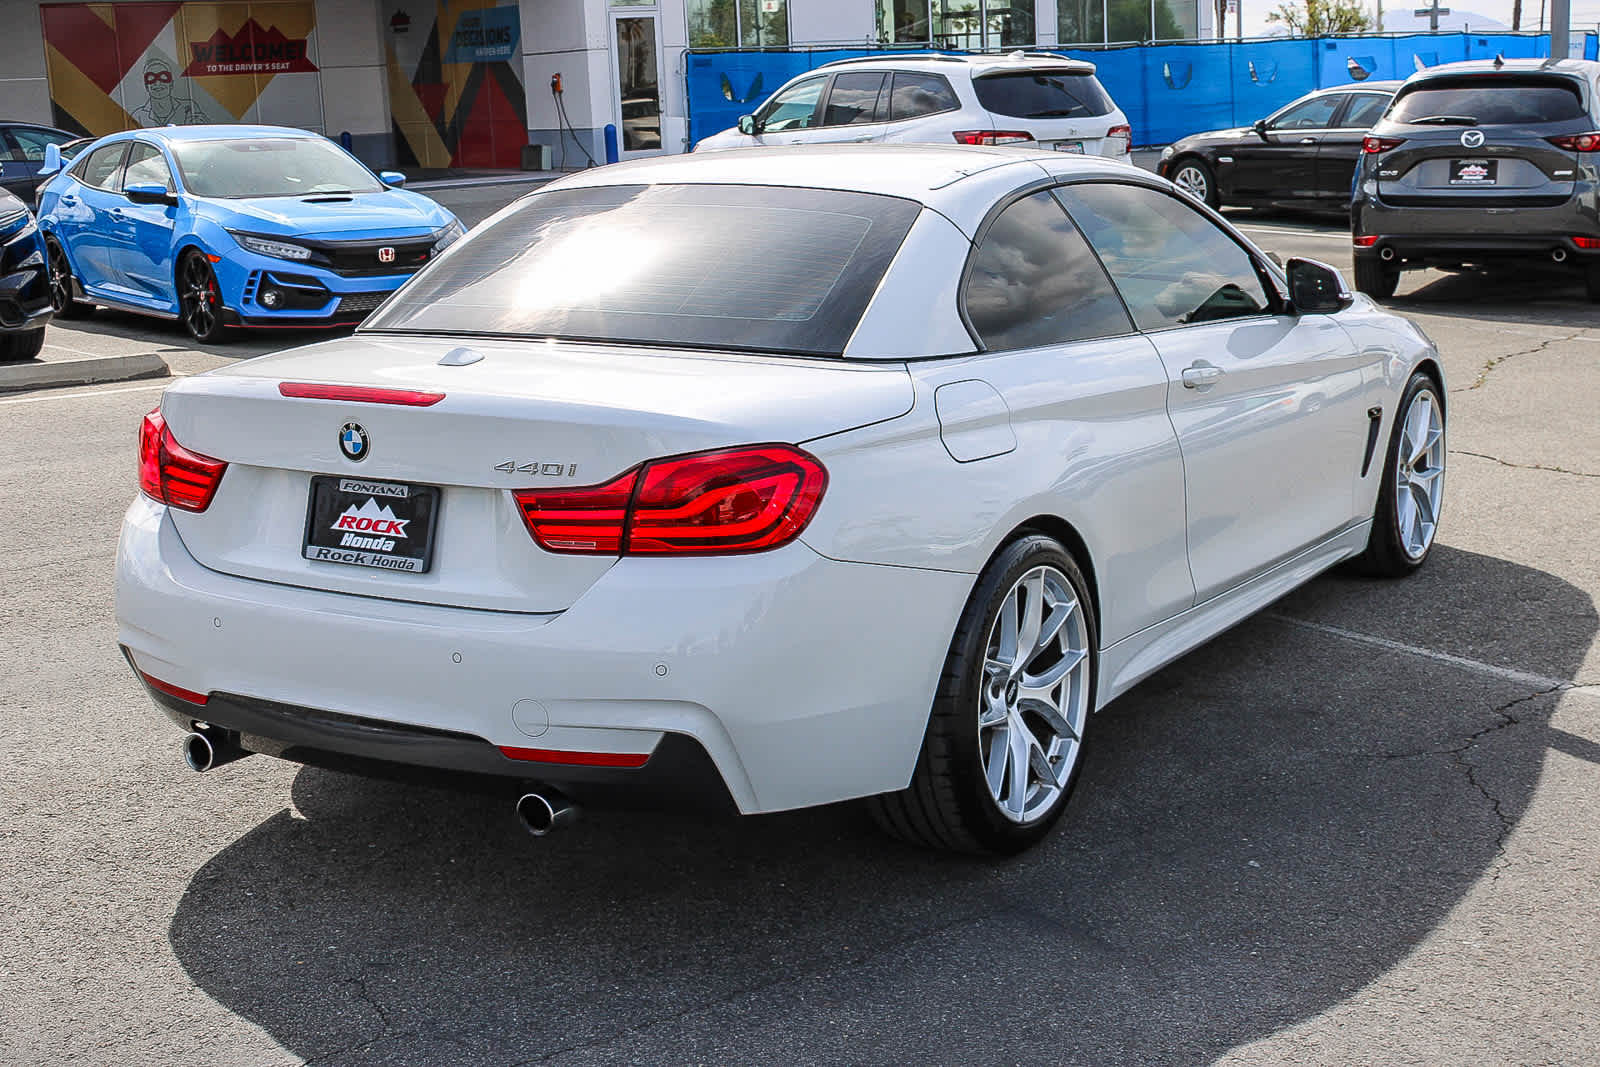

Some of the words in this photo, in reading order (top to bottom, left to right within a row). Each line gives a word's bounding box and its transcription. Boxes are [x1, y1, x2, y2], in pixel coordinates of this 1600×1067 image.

[193, 41, 305, 62] WELCOME!
[207, 64, 217, 73] TO
[219, 63, 233, 72] THE
[235, 62, 270, 72] DRIVER'S
[271, 62, 291, 70] SEAT
[494, 461, 577, 477] 440i
[343, 482, 406, 497] FONTANA
[338, 515, 403, 535] ROCK
[340, 532, 396, 552] Honda
[370, 554, 415, 570] Honda
